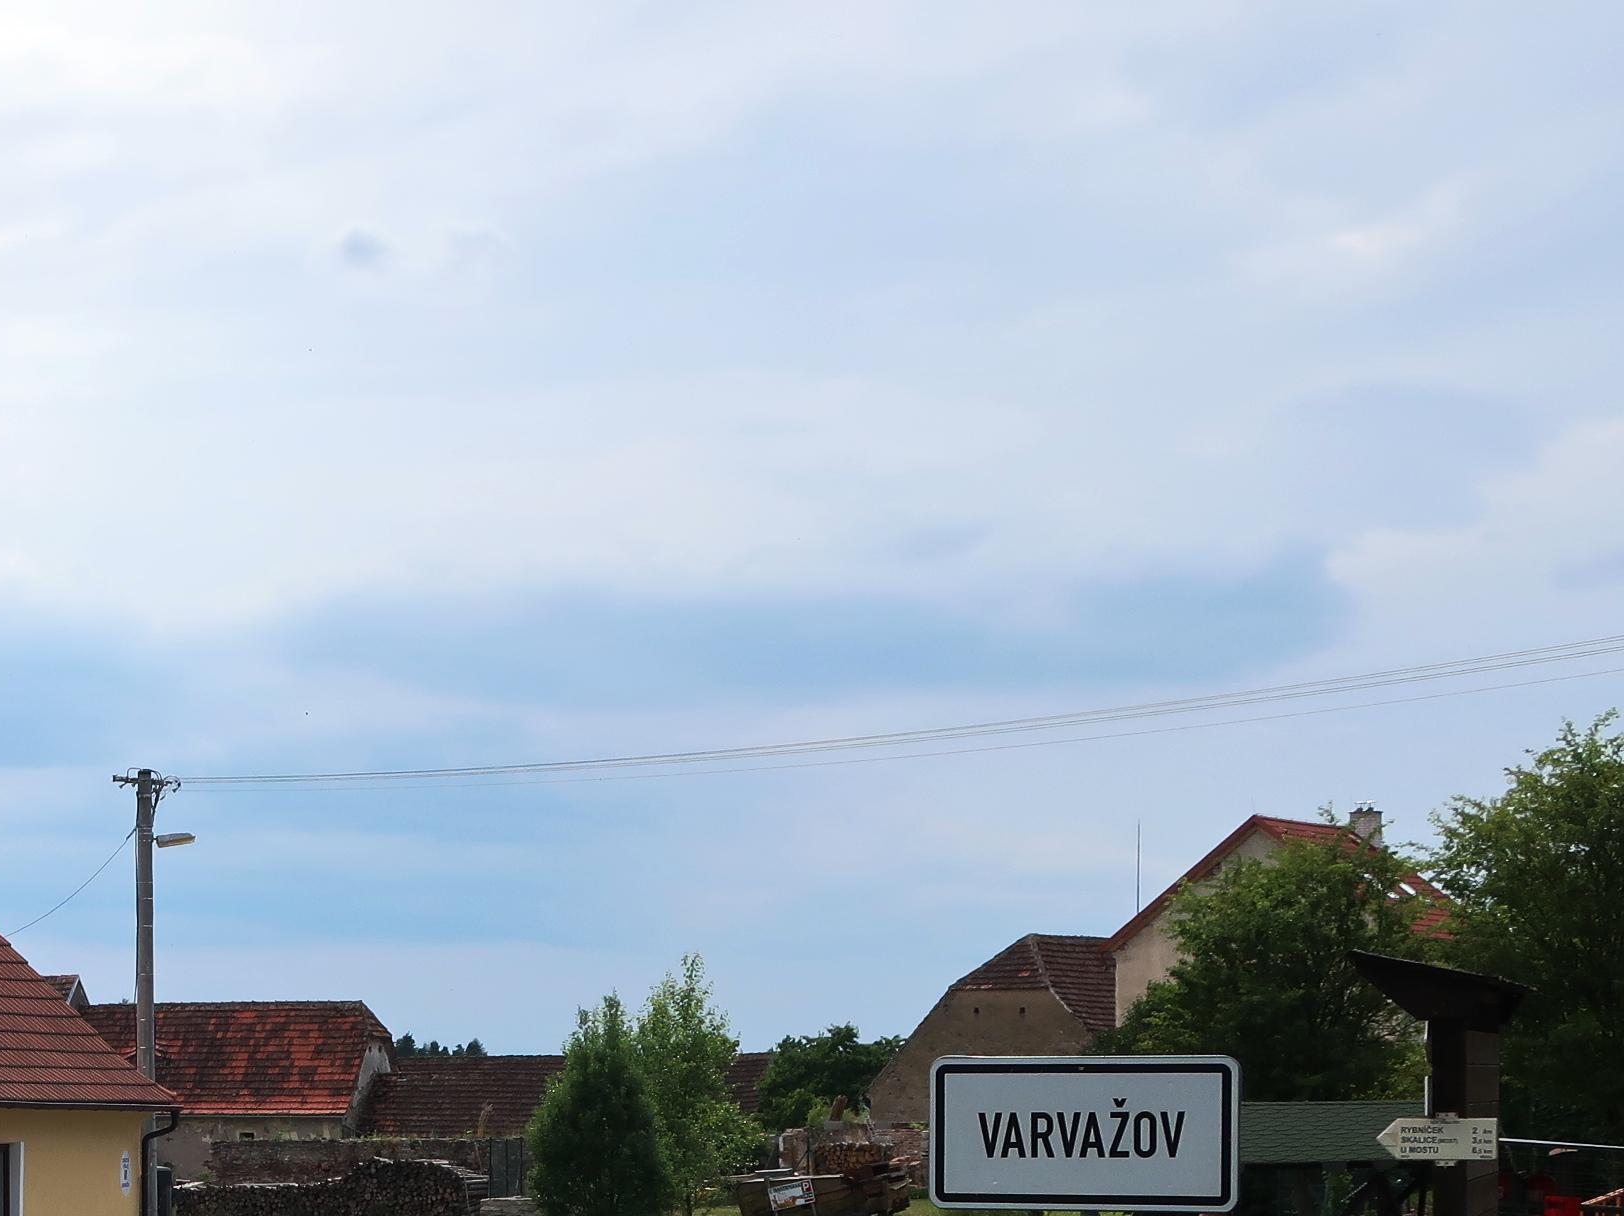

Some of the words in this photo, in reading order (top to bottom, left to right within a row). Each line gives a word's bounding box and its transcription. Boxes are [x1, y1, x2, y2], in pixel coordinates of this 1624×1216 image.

[978, 1098, 1185, 1158] VARVAŽOV
[1400, 1126, 1444, 1134] RYBNÍČEK
[1400, 1136, 1437, 1144] SKALICE
[1400, 1146, 1407, 1154] U
[1408, 1146, 1439, 1154] MOSTU
